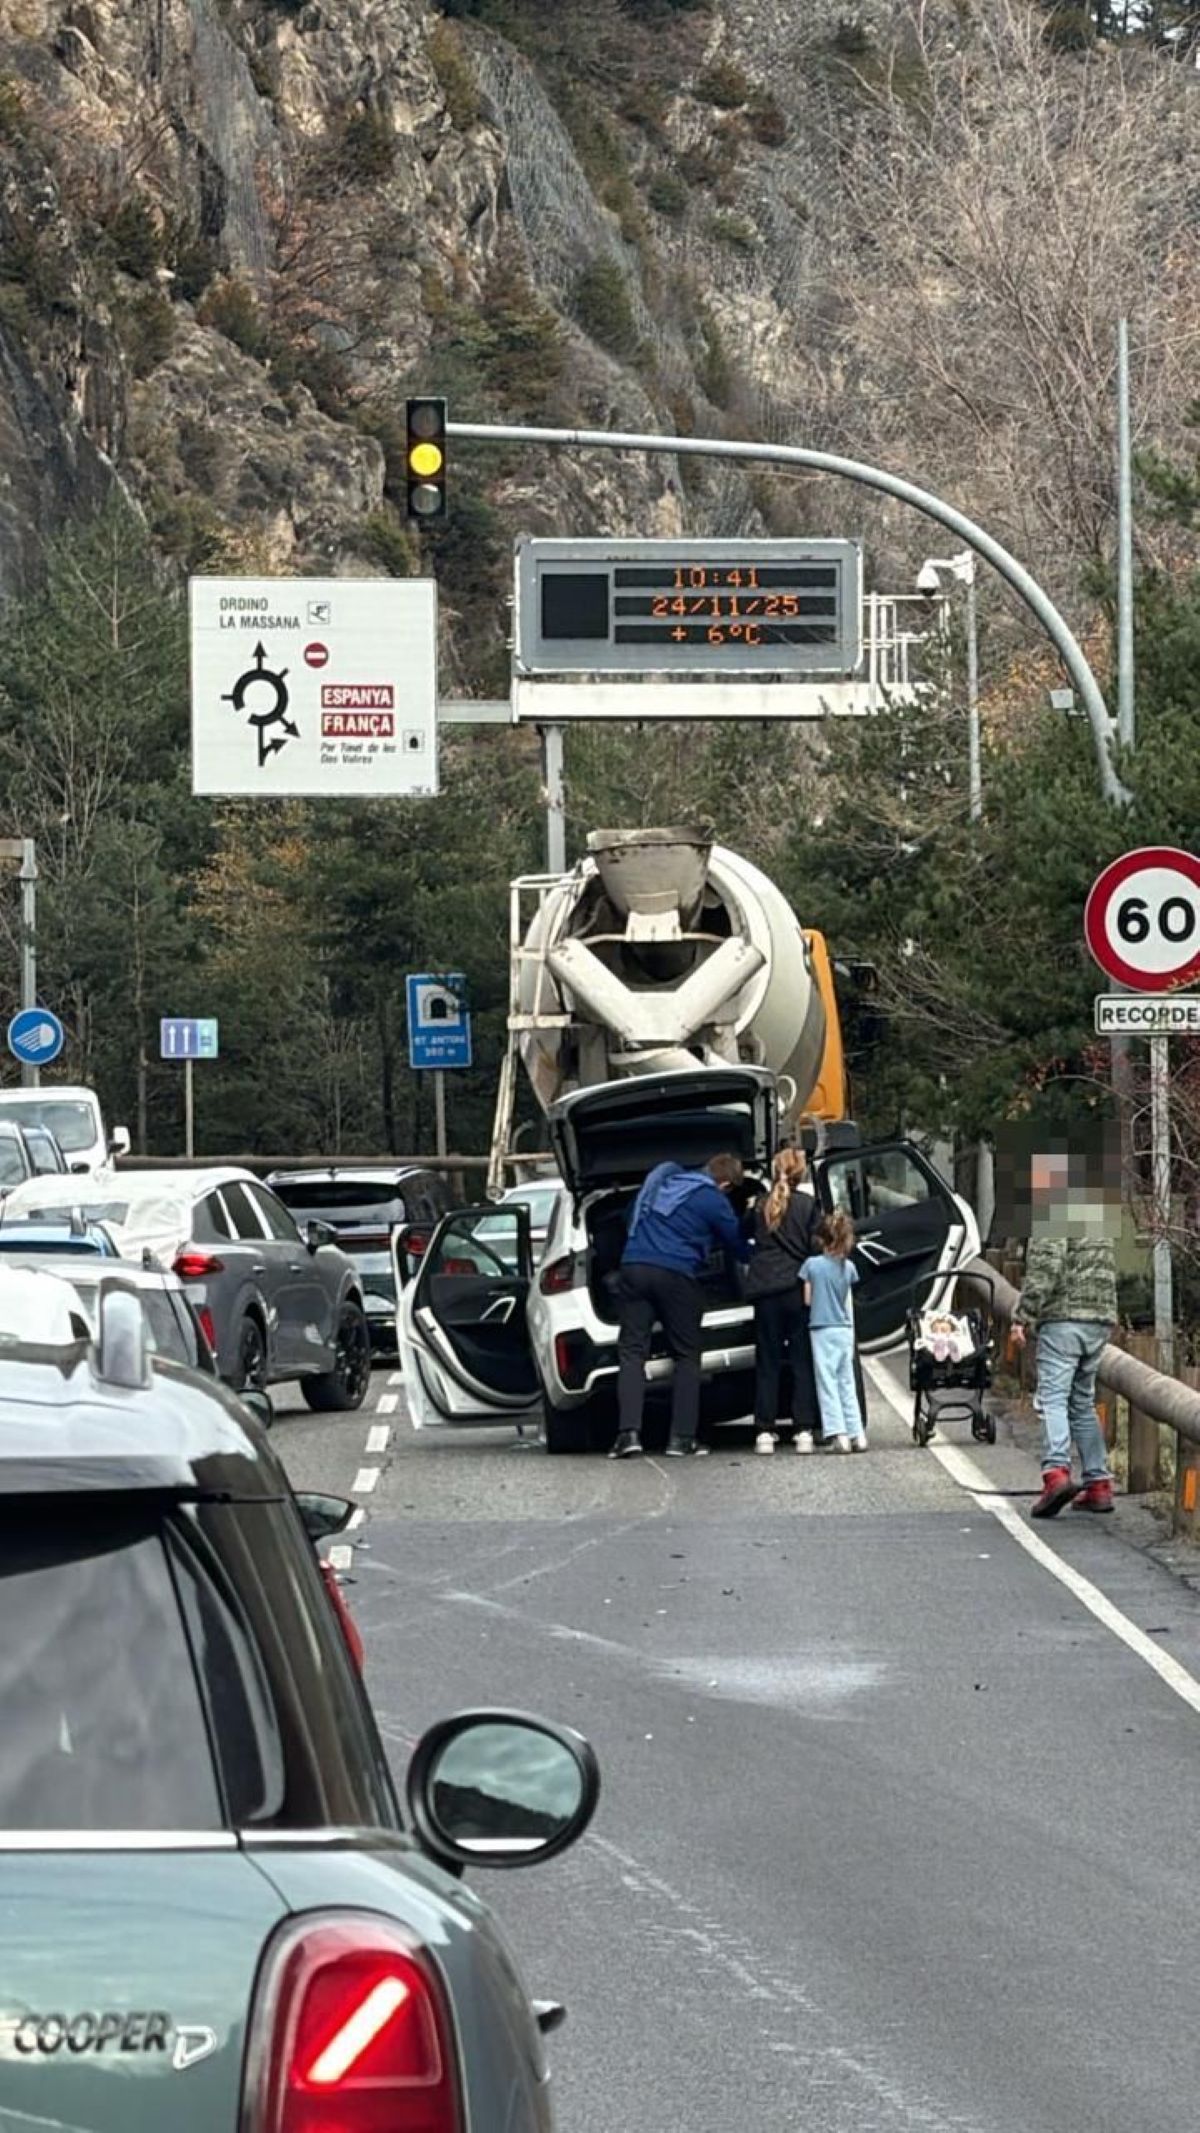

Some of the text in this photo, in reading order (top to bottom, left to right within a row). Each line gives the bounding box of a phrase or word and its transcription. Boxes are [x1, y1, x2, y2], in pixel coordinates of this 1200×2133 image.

[673, 567, 760, 589] 10:41
[219, 597, 269, 611] ORDINO
[652, 595, 800, 616] 24/11/25
[219, 615, 301, 629] LA MASSANA
[323, 688, 392, 706] ESPANYA
[323, 715, 392, 736] FRANÇA
[368, 742, 379, 752] de
[1117, 896, 1196, 944] 60
[14, 2010, 217, 2069] COOPER D
